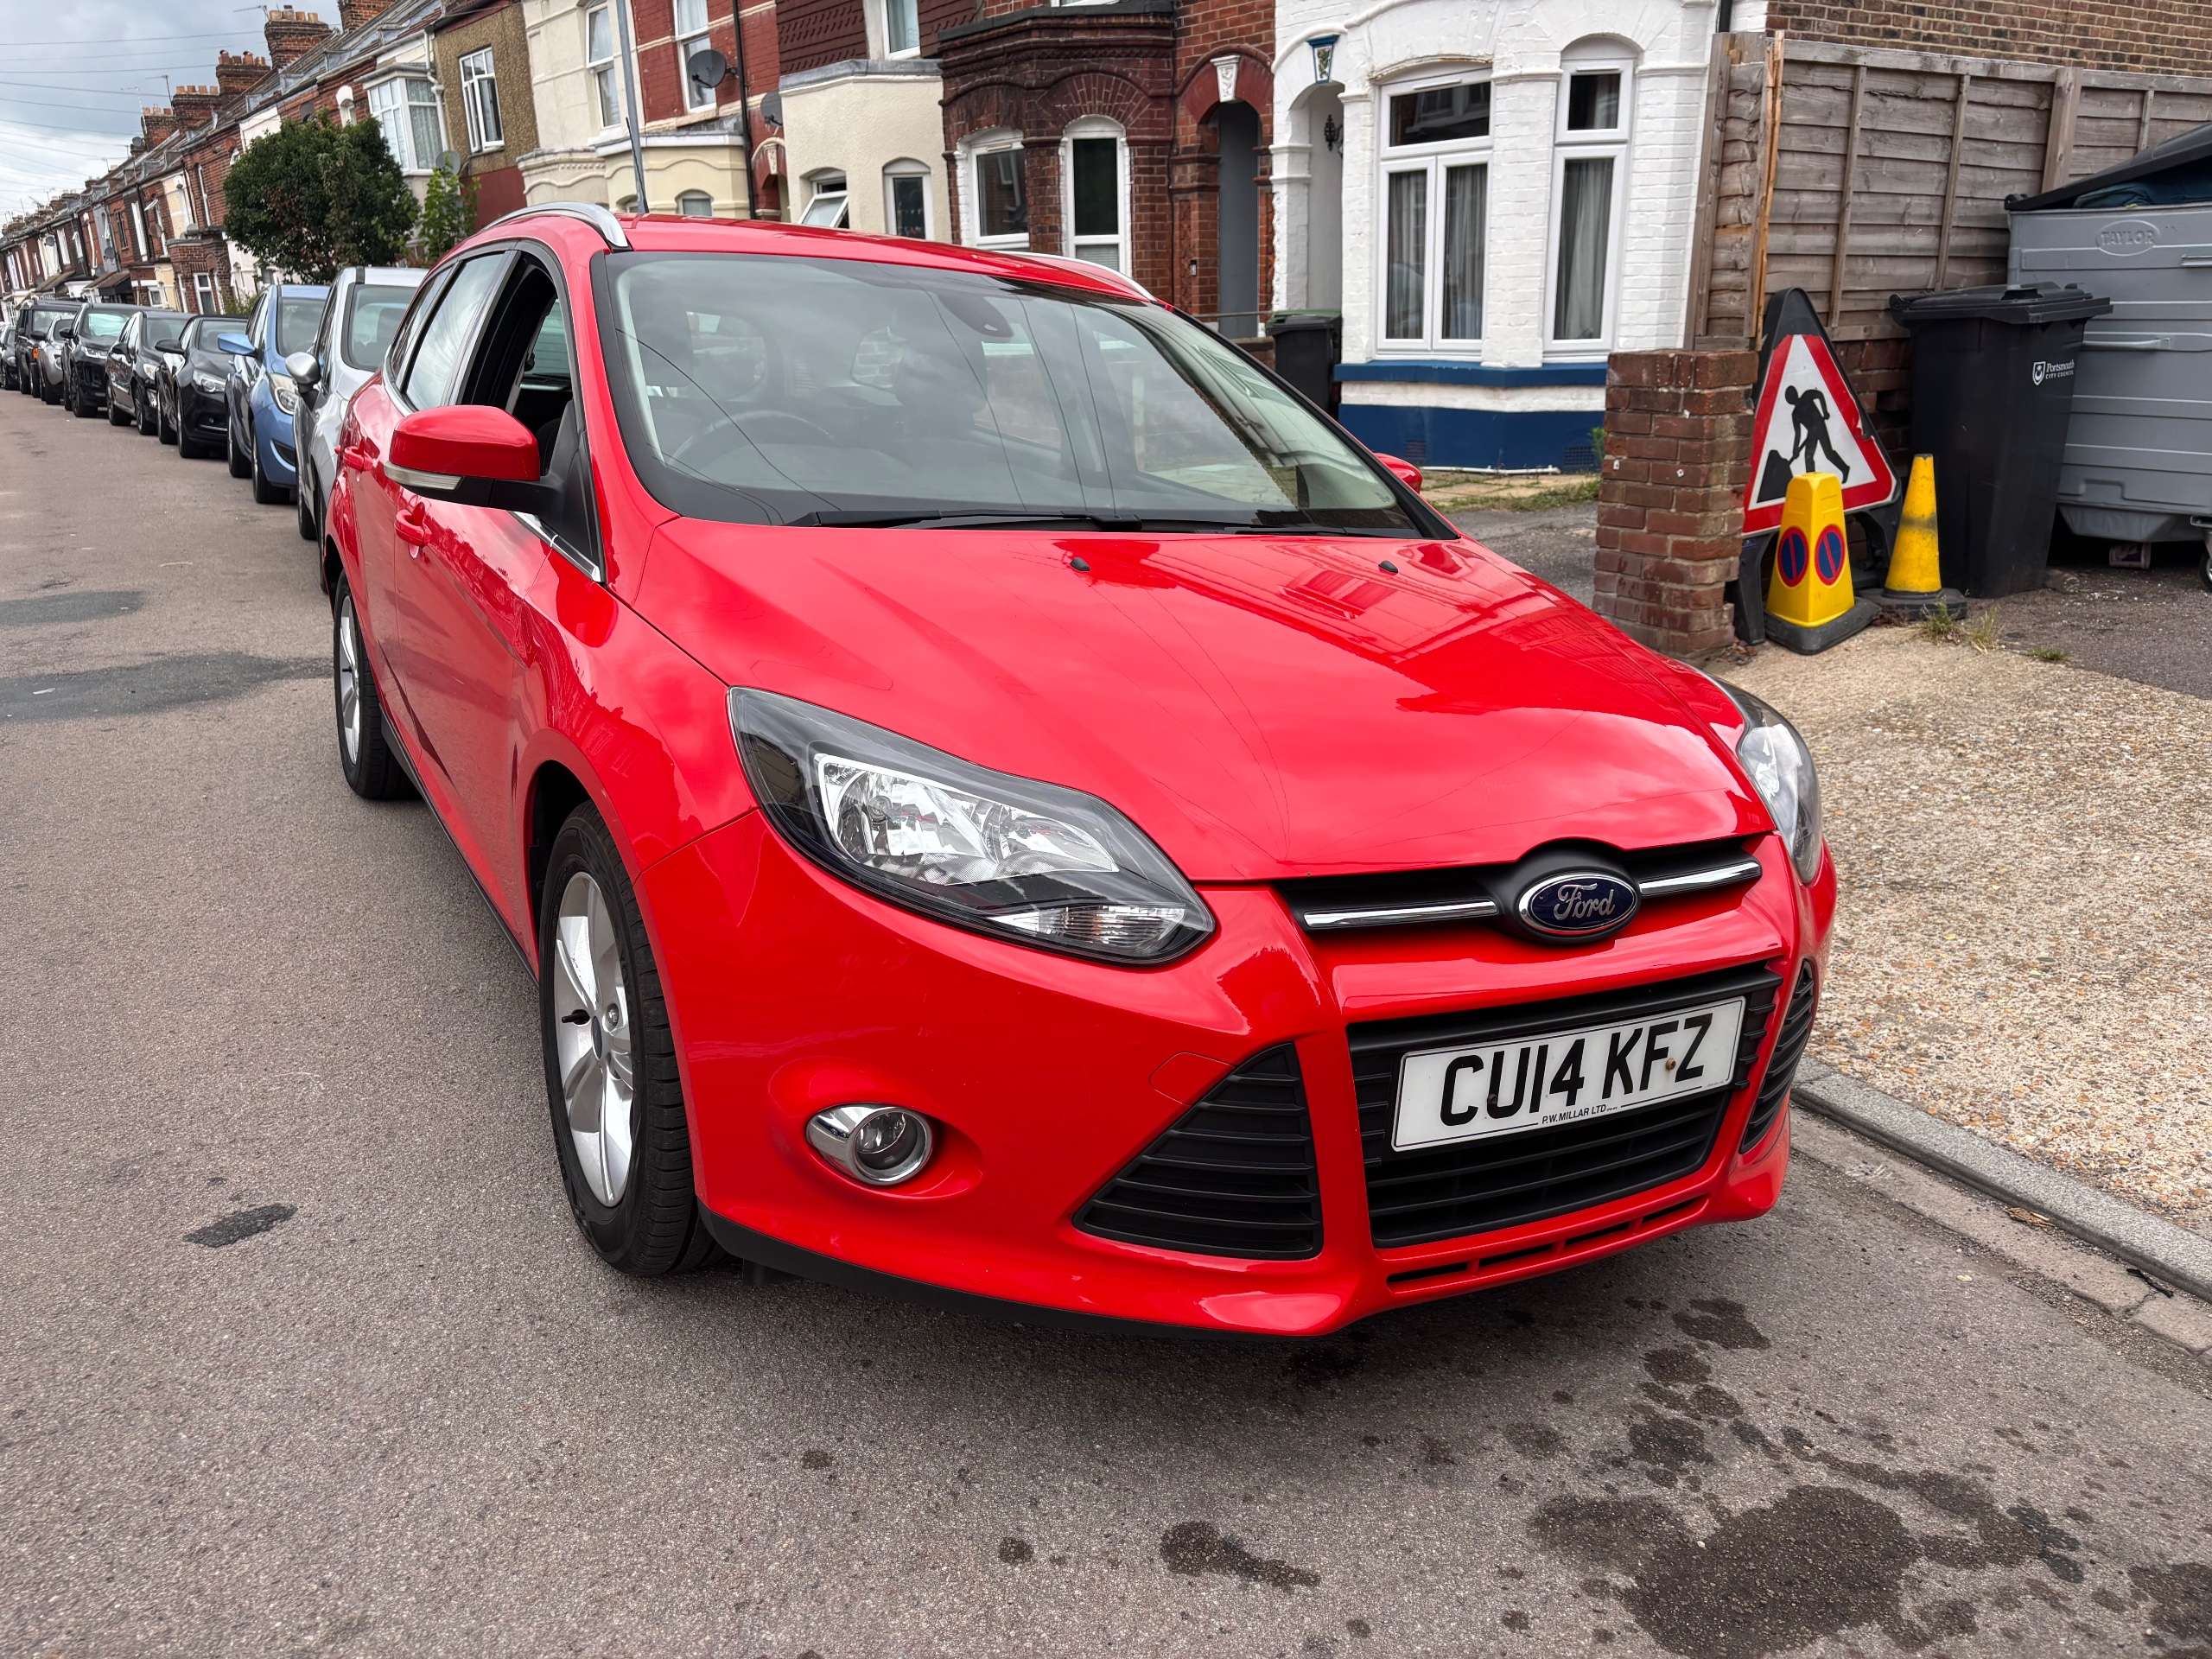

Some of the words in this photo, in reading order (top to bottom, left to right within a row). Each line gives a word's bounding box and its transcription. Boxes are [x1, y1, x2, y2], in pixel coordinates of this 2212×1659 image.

[2101, 230, 2156, 245] TAYLOR
[2046, 359, 2075, 372] Portsmouth
[1554, 883, 1615, 920] Ford
[1440, 1039, 1585, 1127] CU14
[1601, 1013, 1713, 1100] KFZ
[1592, 1104, 1606, 1115] LTD
